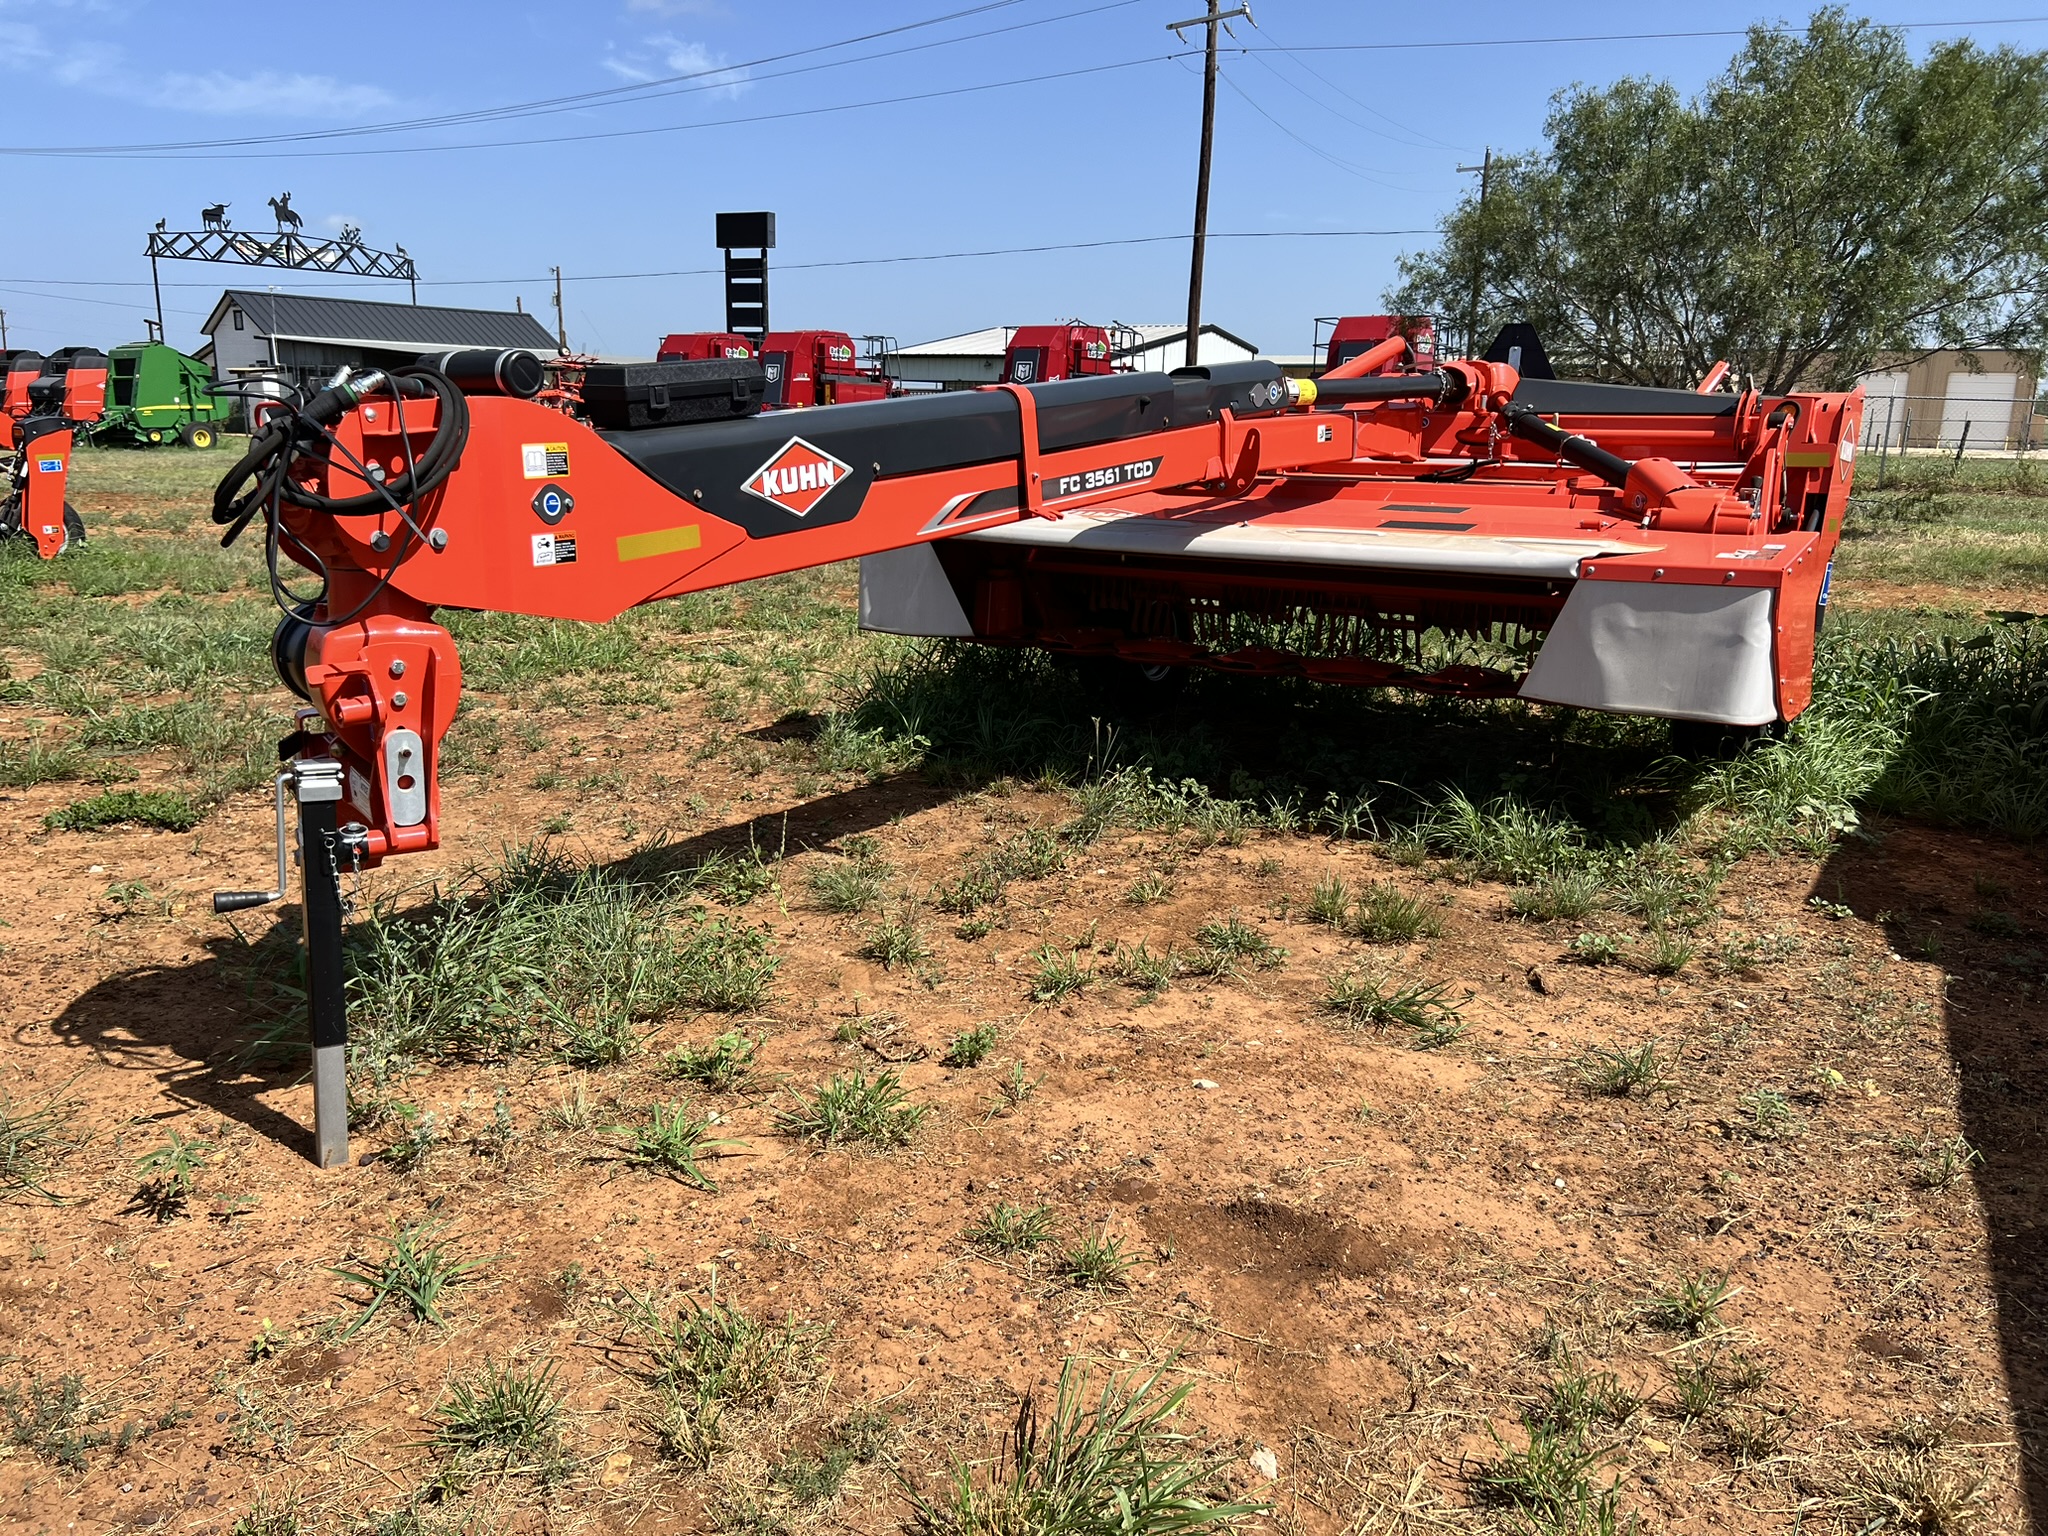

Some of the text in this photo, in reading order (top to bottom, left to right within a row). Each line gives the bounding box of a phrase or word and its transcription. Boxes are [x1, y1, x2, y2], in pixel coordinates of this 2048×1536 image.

[761, 460, 835, 497] KUHN
[1060, 461, 1153, 495] FC 3561 TCD
